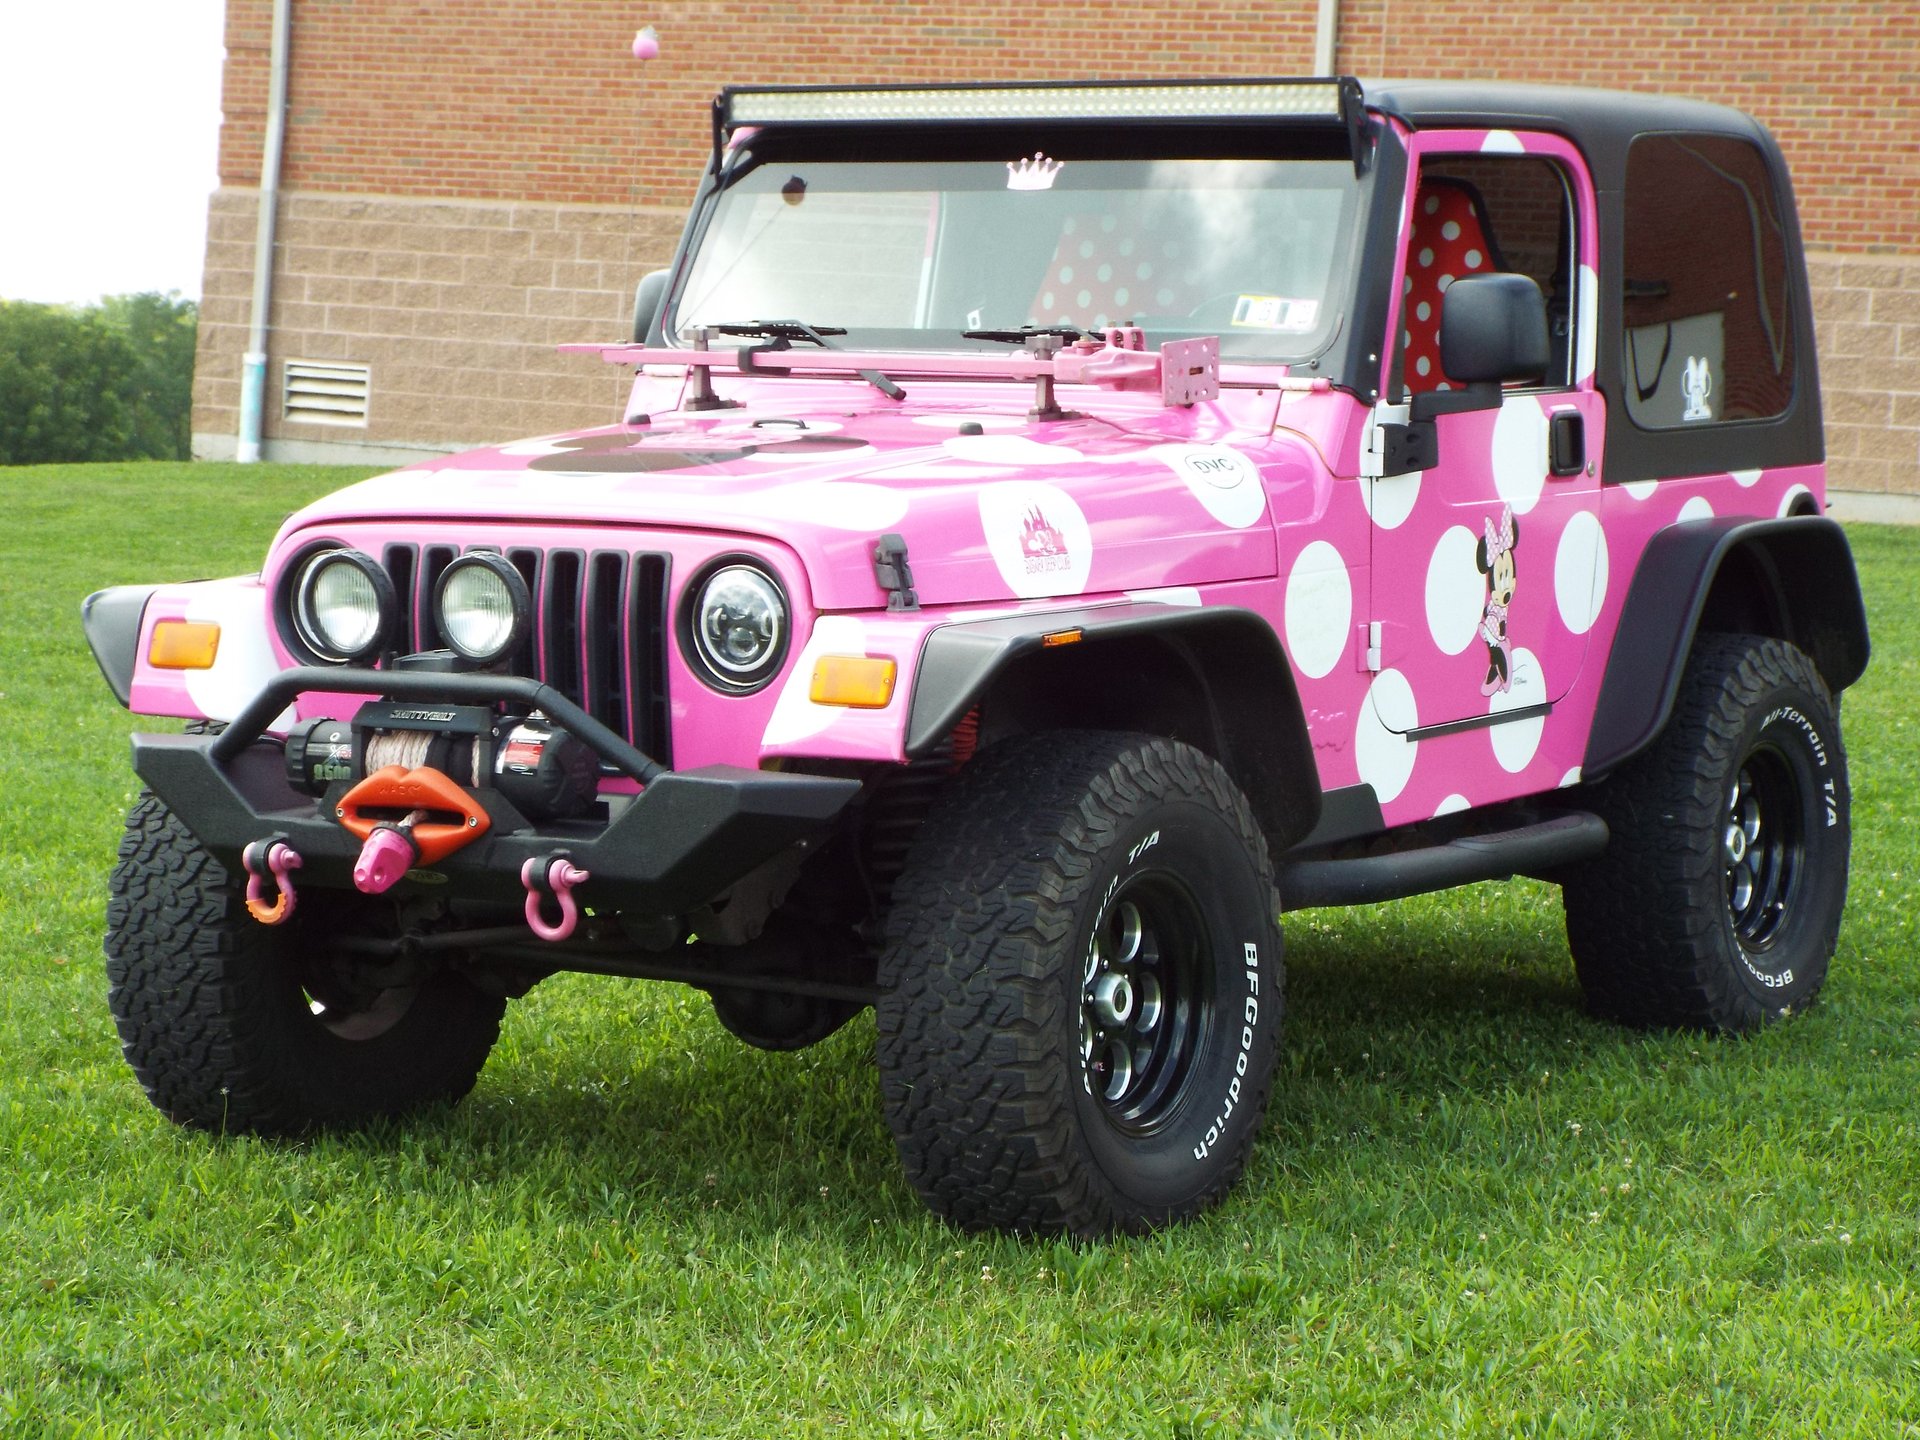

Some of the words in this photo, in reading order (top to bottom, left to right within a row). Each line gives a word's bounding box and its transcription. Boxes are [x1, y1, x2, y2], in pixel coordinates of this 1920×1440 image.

[1193, 458, 1234, 474] DVC
[1759, 705, 1828, 766] All-Terrain
[1824, 778, 1838, 827] T/A
[1128, 829, 1160, 865] T/A
[1193, 942, 1259, 1161] BFGoodrich
